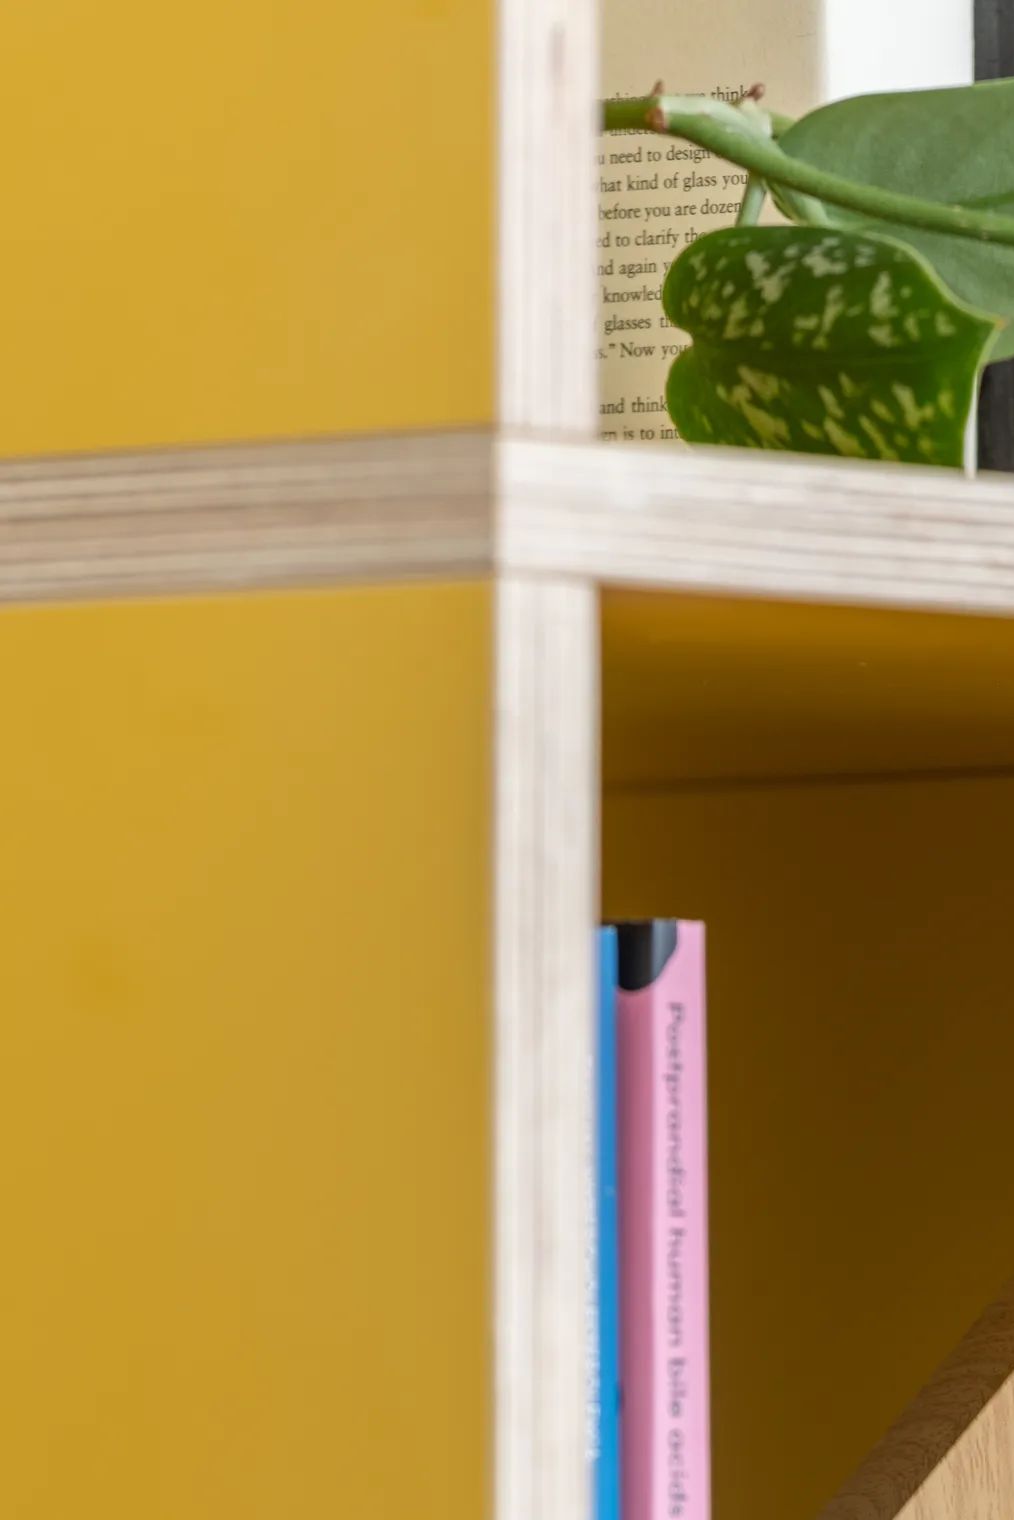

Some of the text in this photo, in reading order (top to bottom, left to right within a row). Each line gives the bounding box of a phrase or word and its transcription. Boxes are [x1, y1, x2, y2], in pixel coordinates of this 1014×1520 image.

[609, 147, 642, 164] need
[647, 149, 662, 162] to
[666, 145, 711, 164] design
[598, 171, 749, 193] hat kind of glass you
[598, 203, 641, 221] before
[644, 207, 671, 222] you
[674, 204, 697, 216] are
[615, 235, 631, 248] to
[634, 228, 680, 249] clarify
[597, 259, 614, 276] nd
[619, 258, 657, 279] again
[603, 284, 663, 304] knowled
[603, 314, 652, 335] glasses
[620, 341, 656, 359] Now
[599, 395, 668, 415] and think
[623, 425, 635, 441] is
[640, 428, 655, 441] to
[660, 424, 680, 440] int
[663, 1002, 686, 1217] Postprandial
[667, 1229, 686, 1347] human
[667, 1357, 687, 1418] bile
[667, 1428, 688, 1518] acids
